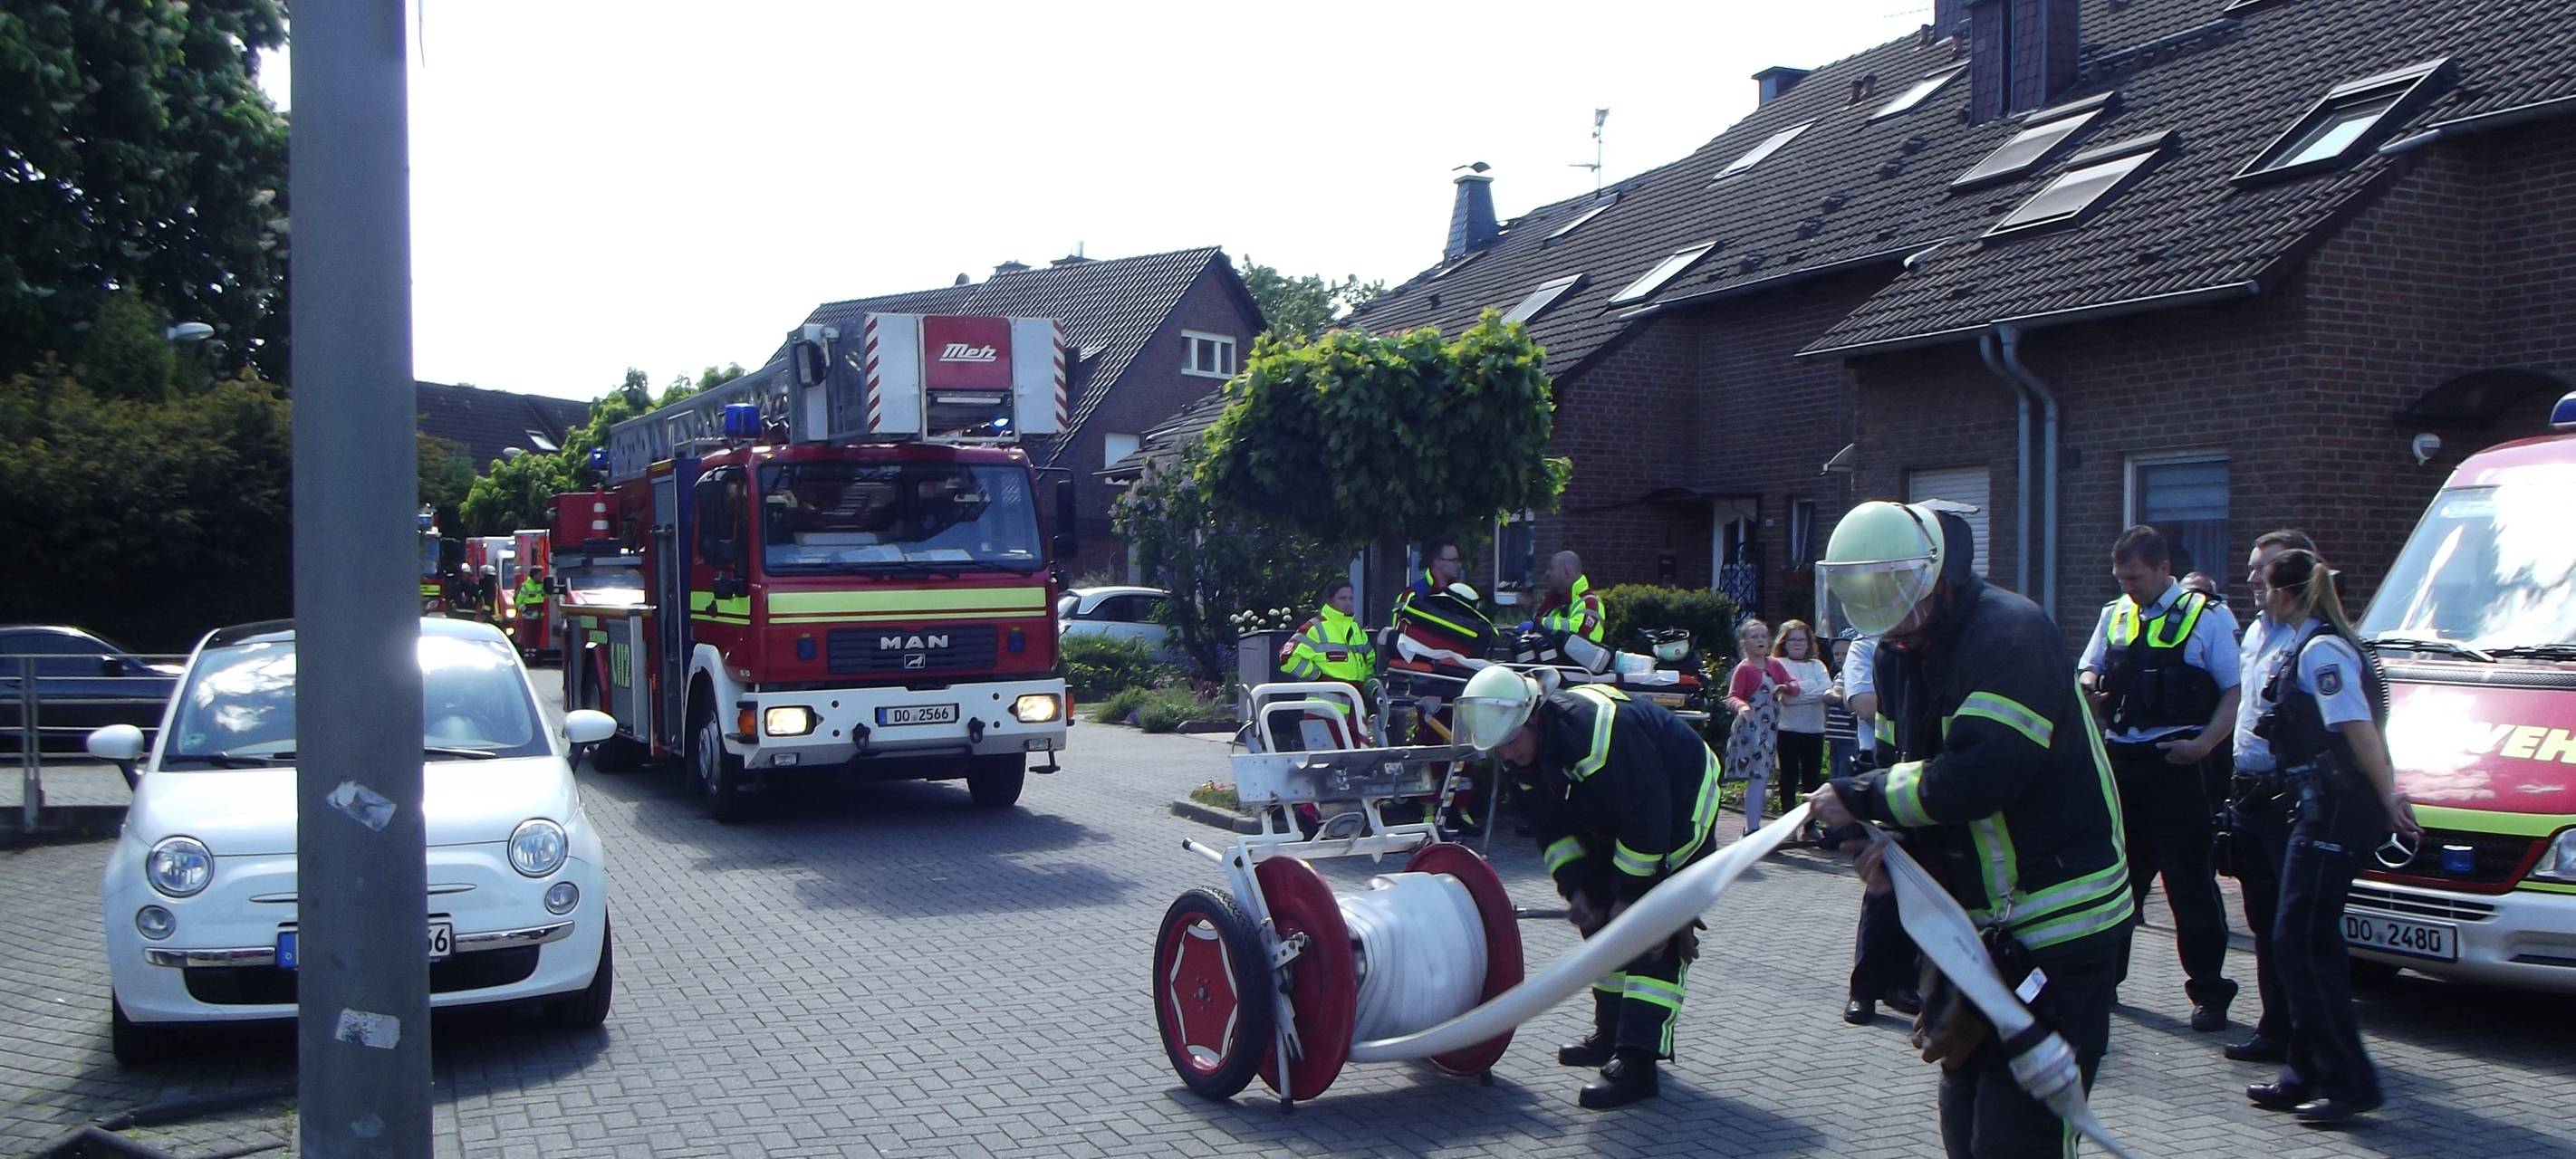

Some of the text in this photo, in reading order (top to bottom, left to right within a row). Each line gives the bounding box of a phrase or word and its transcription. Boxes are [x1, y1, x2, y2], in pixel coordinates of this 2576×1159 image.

[939, 343, 997, 361] Metz
[880, 636, 948, 650] MAN
[894, 707, 948, 723] DO 2566
[2347, 917, 2441, 953] DO 2480
